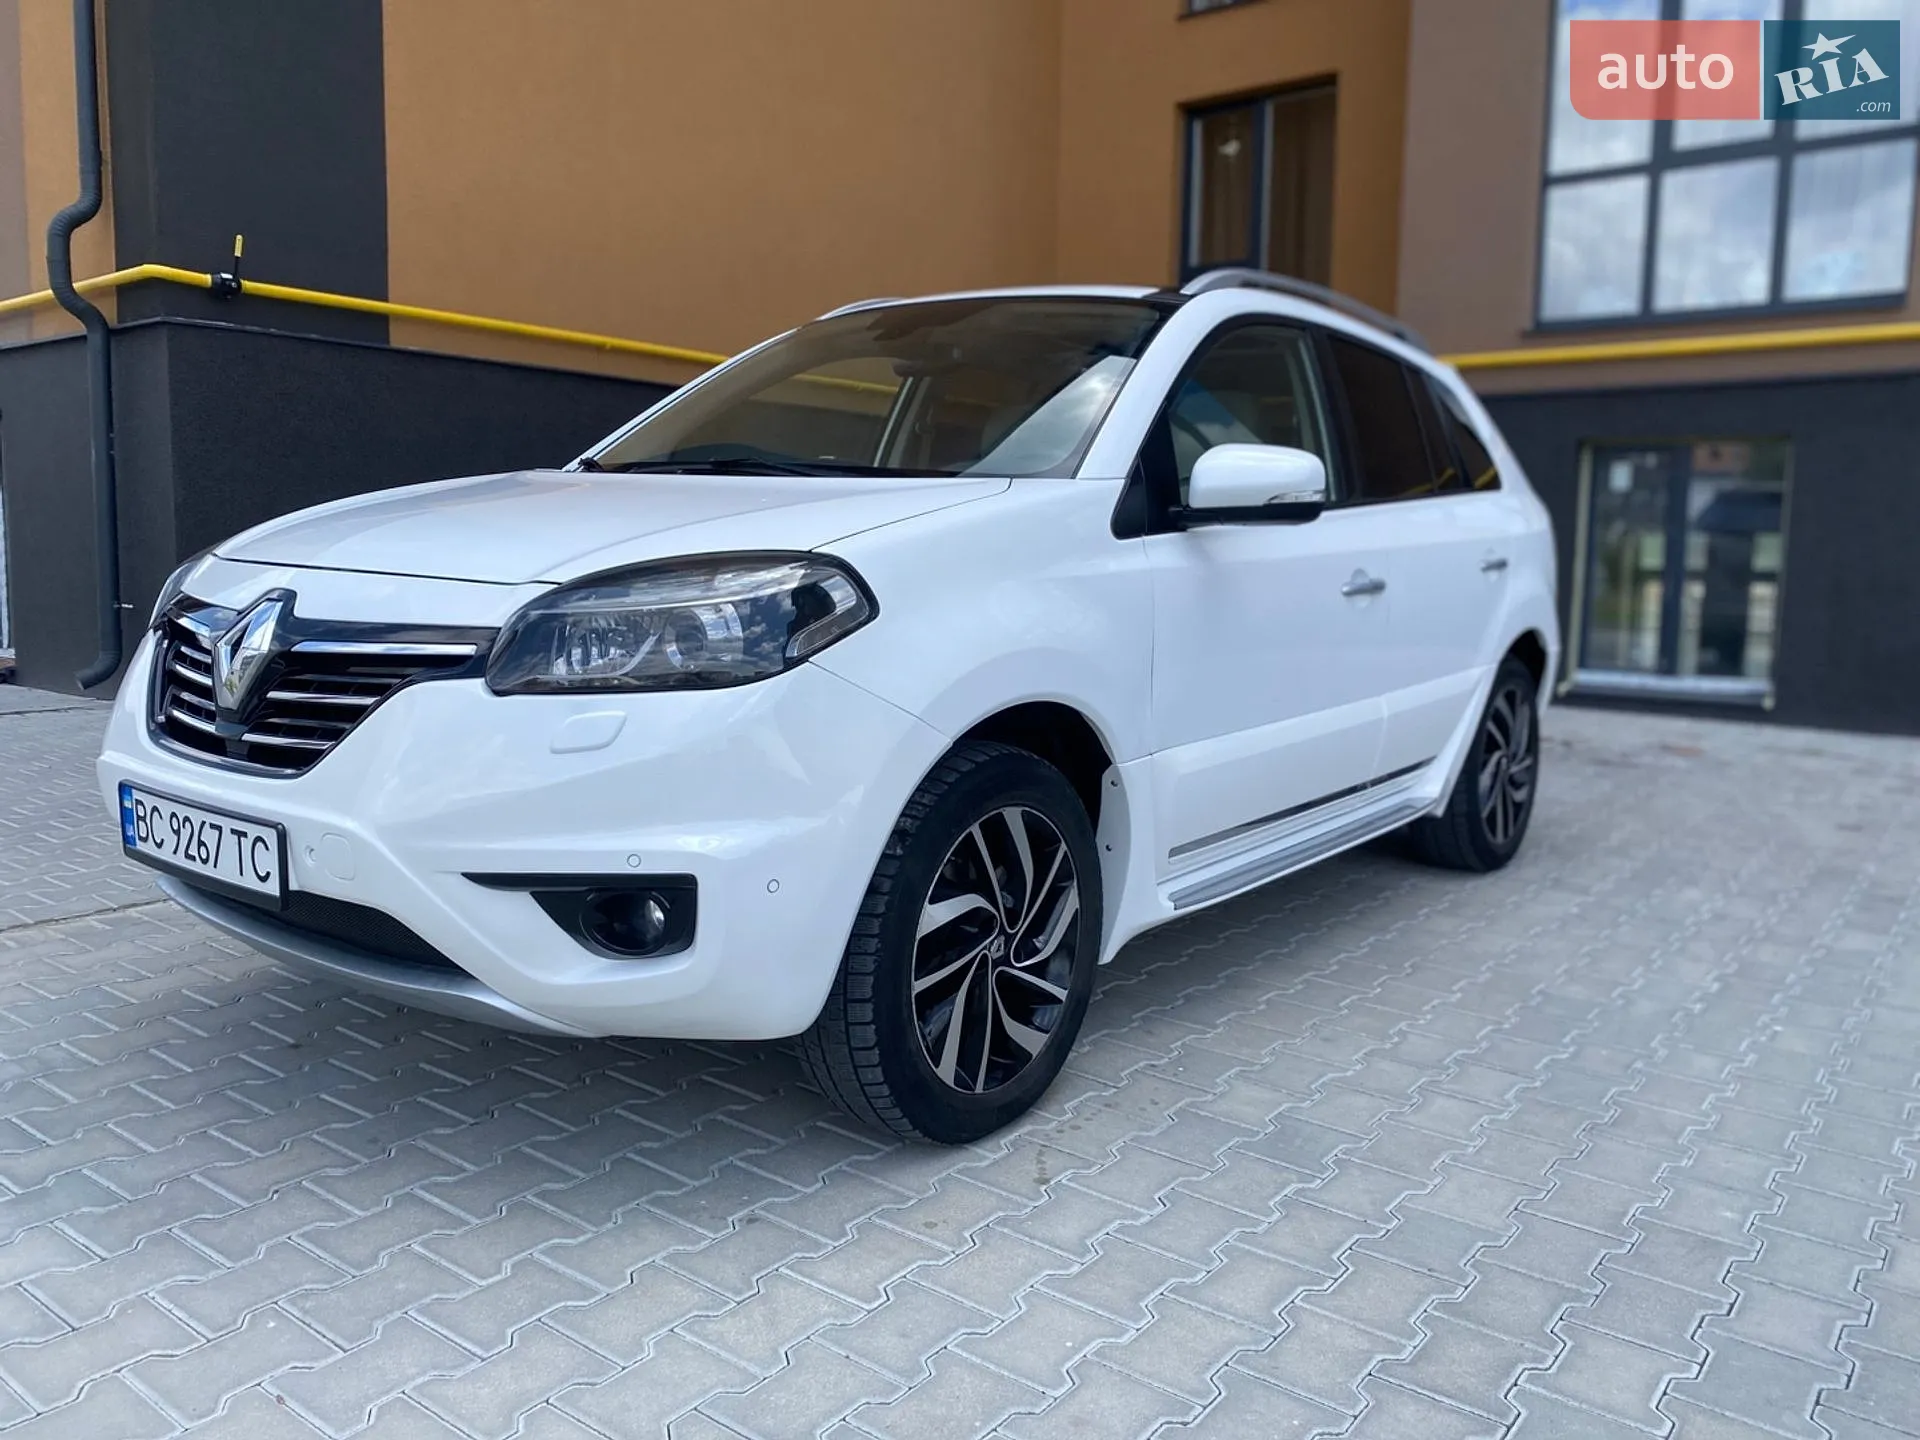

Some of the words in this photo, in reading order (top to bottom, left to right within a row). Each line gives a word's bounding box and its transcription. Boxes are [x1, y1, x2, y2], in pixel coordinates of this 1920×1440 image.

[134, 798, 165, 850] BC
[169, 811, 223, 869] 9267
[230, 827, 271, 883] TC
